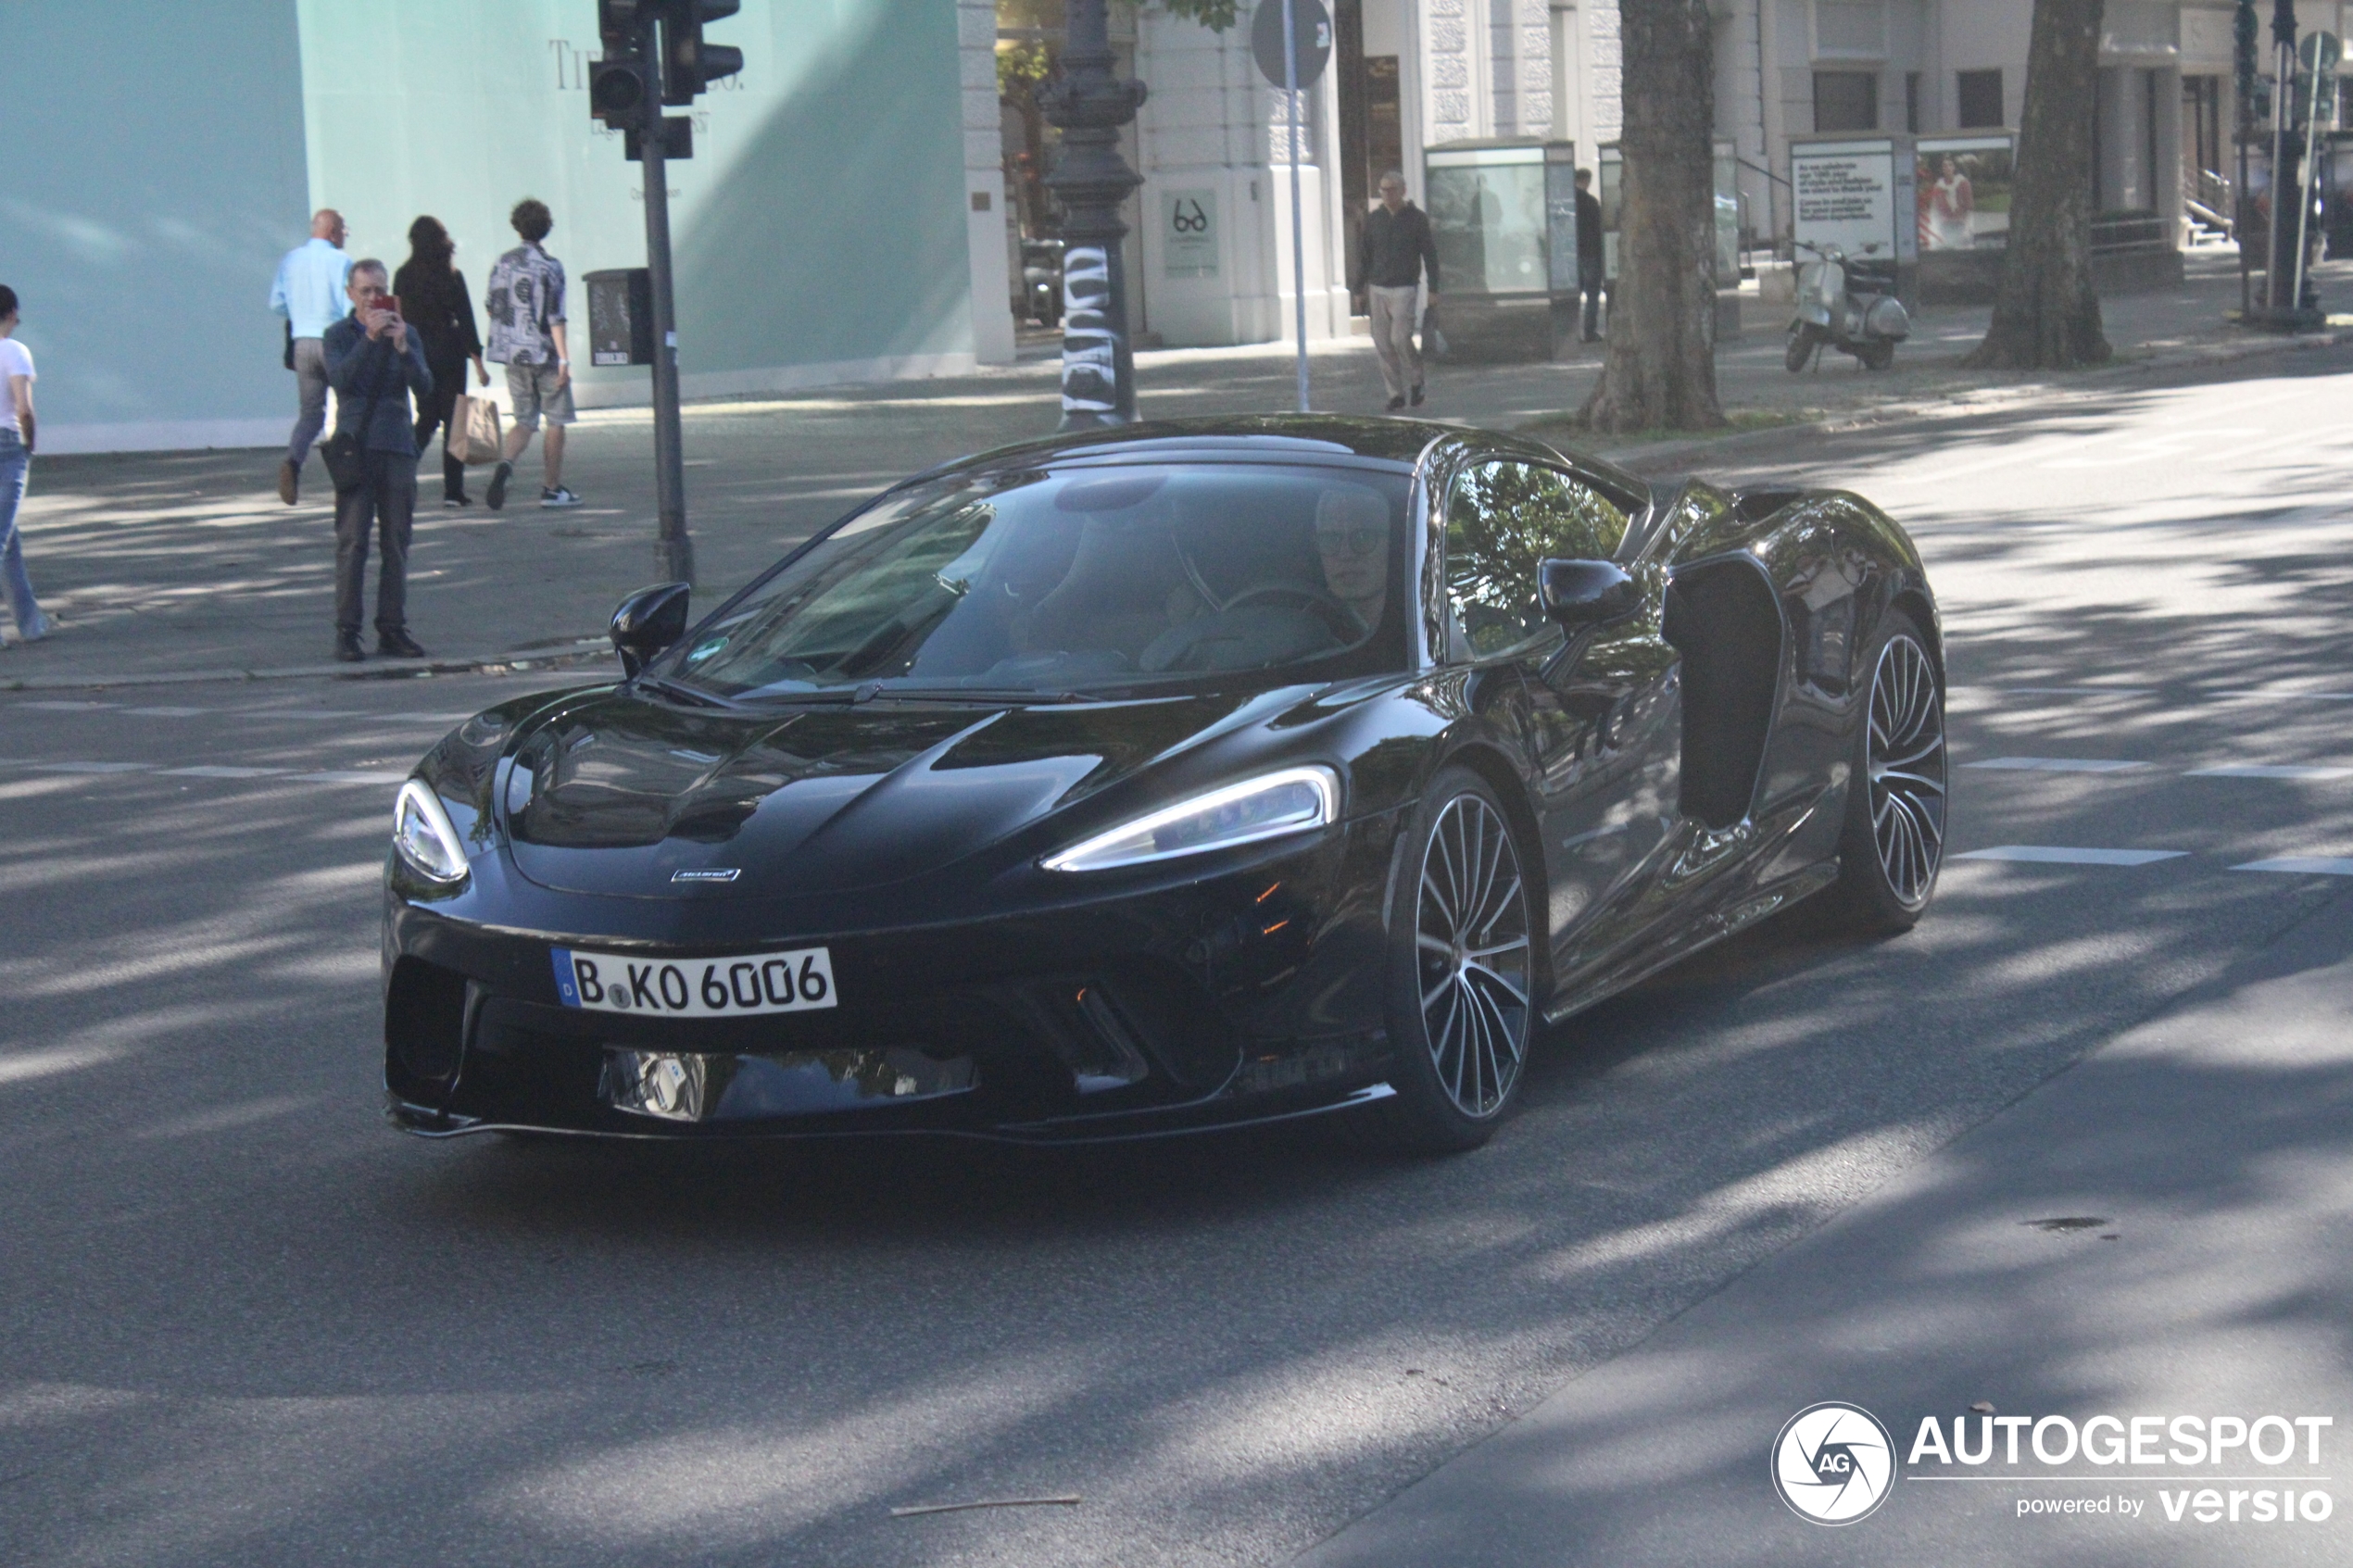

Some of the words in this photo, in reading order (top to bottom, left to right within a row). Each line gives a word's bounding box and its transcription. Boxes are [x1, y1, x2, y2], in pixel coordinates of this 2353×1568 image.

[563, 983, 573, 997] D
[574, 958, 605, 1003] B
[627, 963, 688, 1010] KO
[700, 955, 828, 1010] 6006
